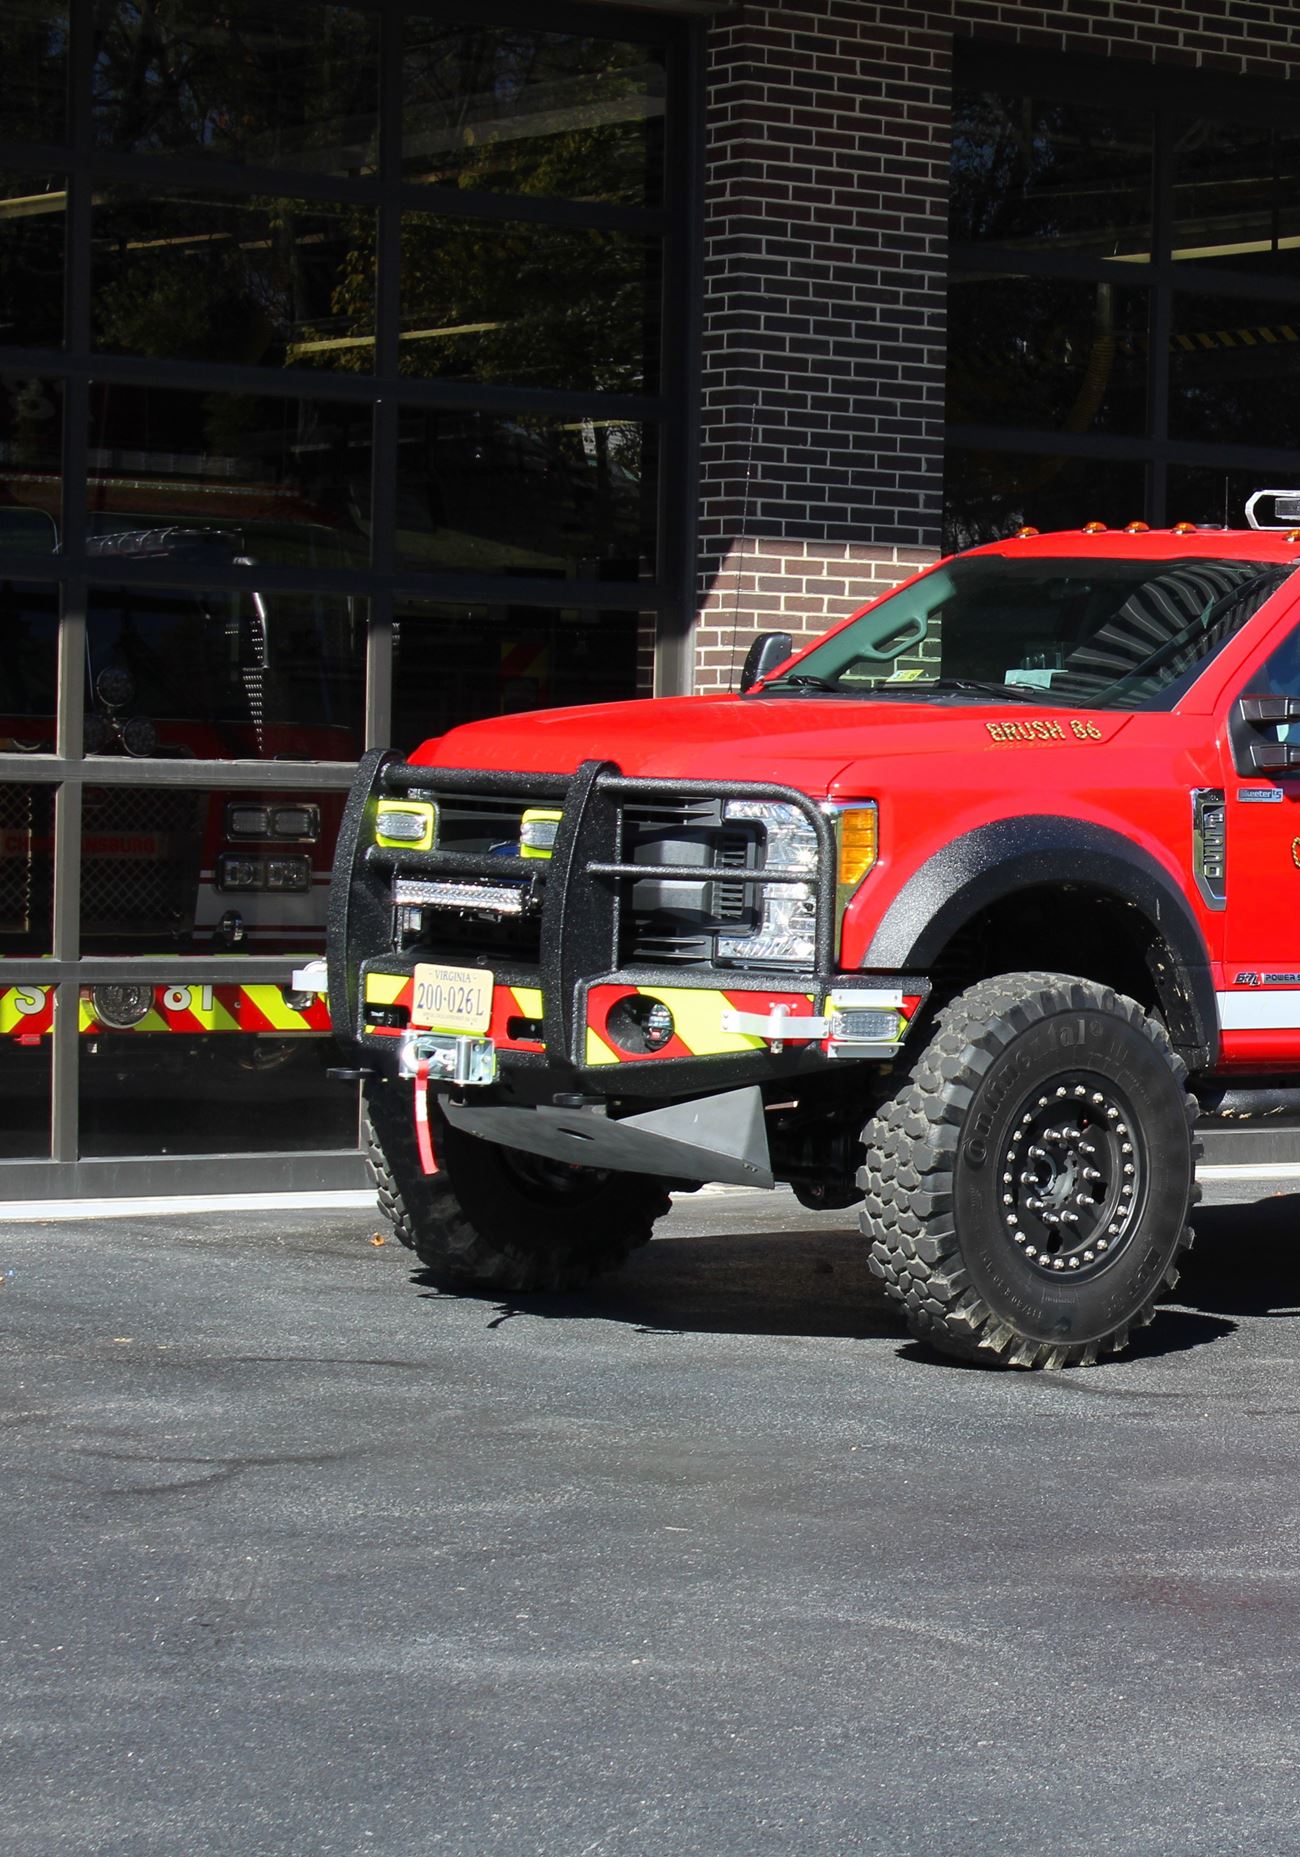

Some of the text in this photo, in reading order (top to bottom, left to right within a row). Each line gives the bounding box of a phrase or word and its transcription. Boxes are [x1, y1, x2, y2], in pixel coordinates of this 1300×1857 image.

[985, 719, 1102, 742] BRUSH 86
[434, 969, 472, 983] VIRGINIA
[1265, 973, 1296, 981] POWER
